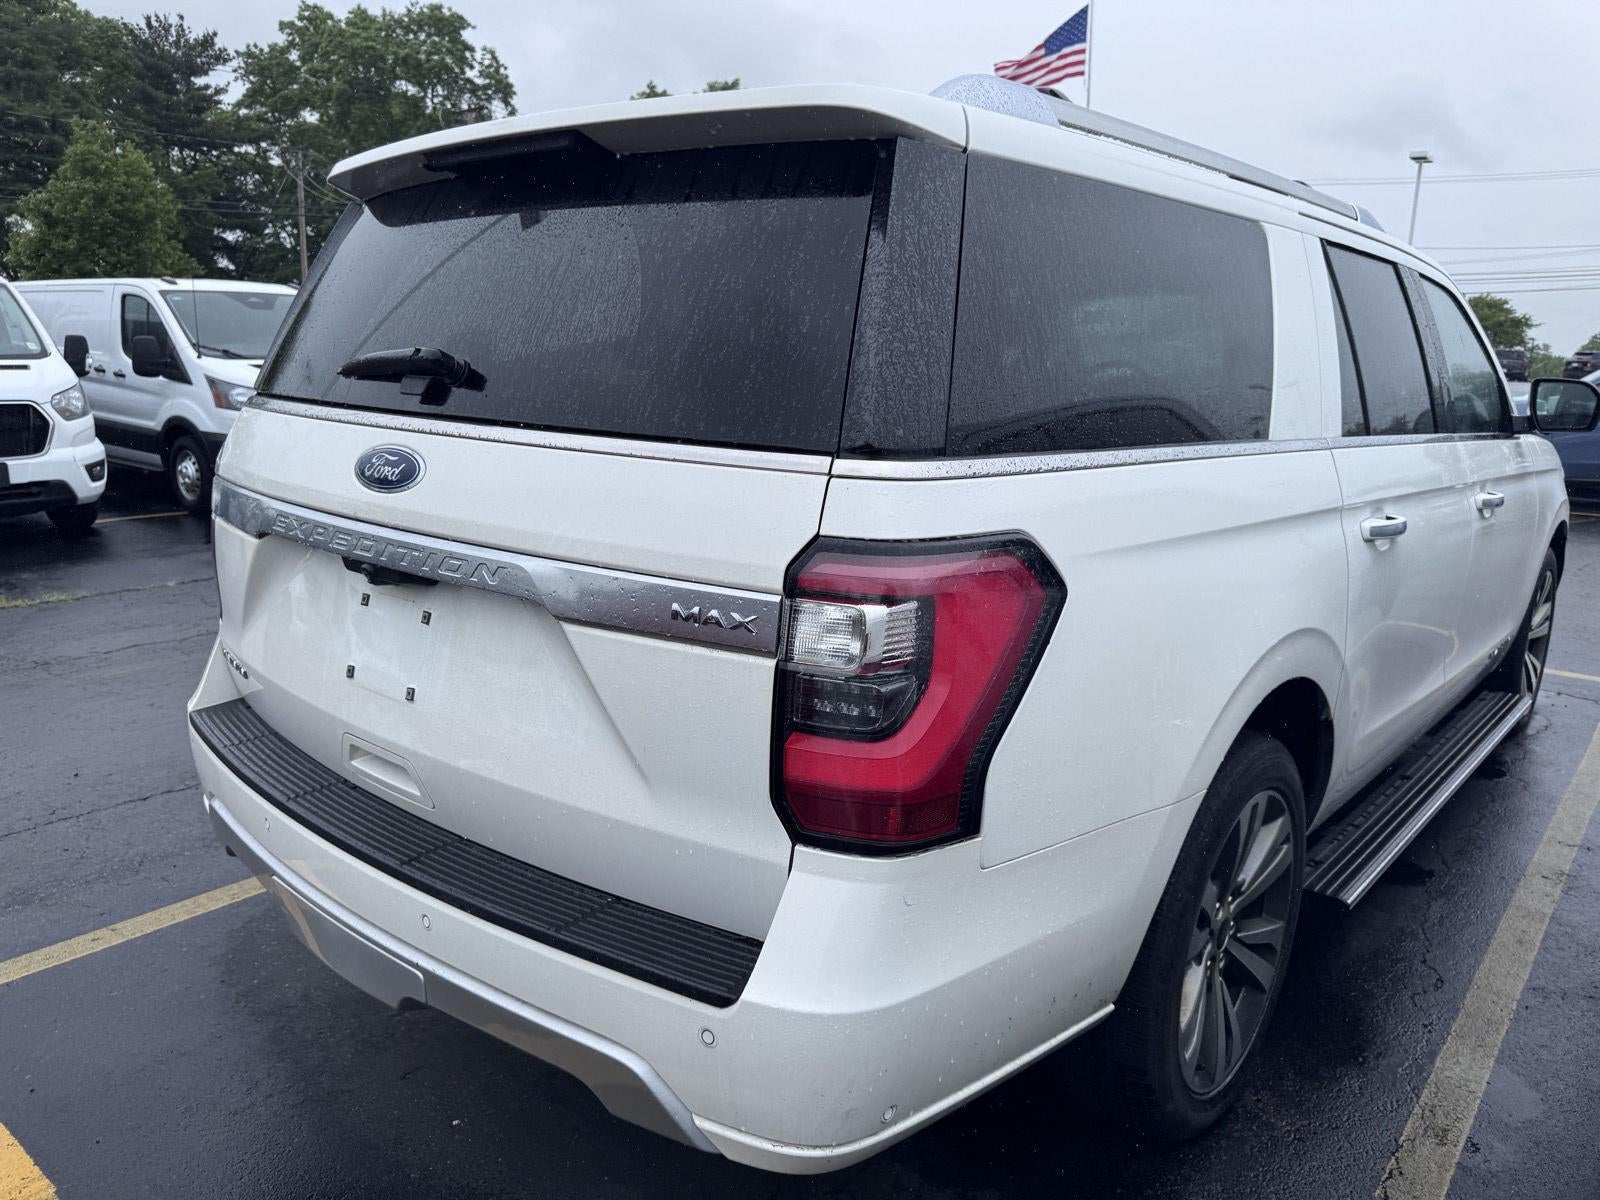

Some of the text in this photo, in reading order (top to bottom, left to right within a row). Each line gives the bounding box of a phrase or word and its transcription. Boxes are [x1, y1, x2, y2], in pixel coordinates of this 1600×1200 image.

[364, 453, 406, 481] Ford
[272, 513, 508, 585] EXPEDITION
[671, 602, 759, 635] MAX
